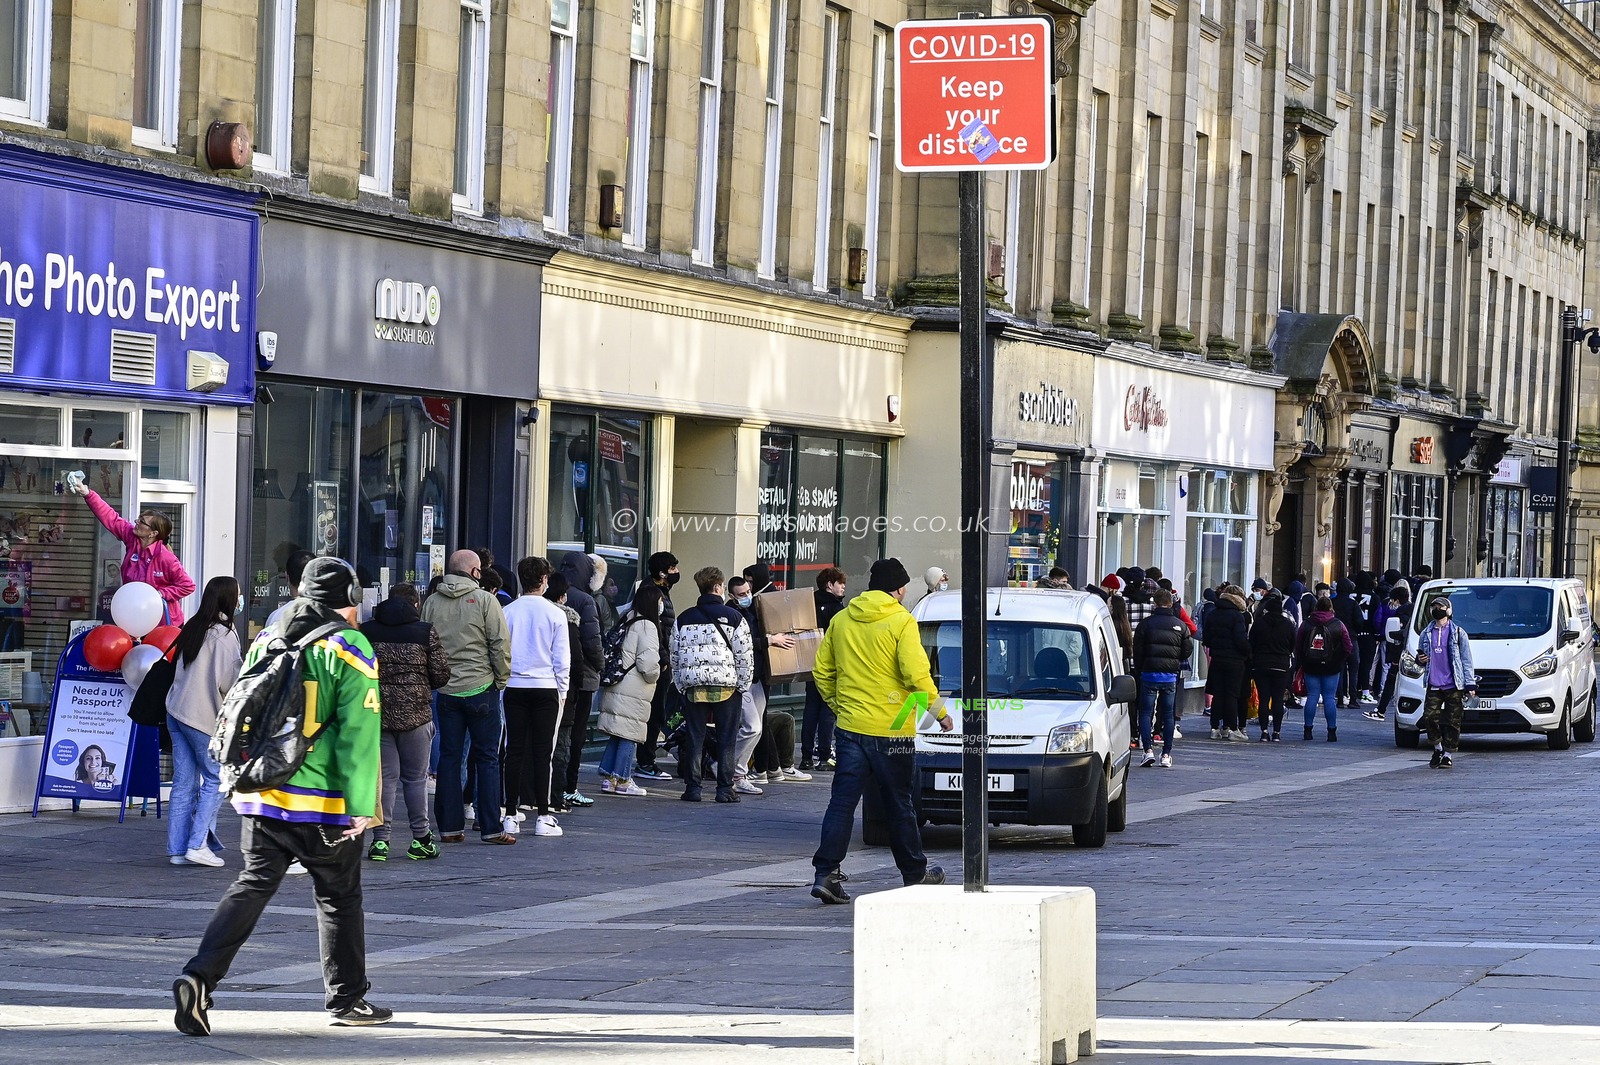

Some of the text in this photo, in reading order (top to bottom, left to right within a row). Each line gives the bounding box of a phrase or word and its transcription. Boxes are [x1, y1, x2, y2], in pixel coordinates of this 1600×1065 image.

[909, 33, 1035, 59] COVID-19
[941, 76, 1004, 101] Keep
[946, 109, 1000, 131] your
[918, 133, 1028, 155] distce
[0, 247, 241, 341] he Photo Expert
[393, 326, 435, 345] SUSHI BOX
[1021, 381, 1078, 427] scribbler
[758, 486, 838, 508] RETAIL &B SPACE
[1010, 462, 1044, 511] bbler
[760, 512, 789, 533] HERE'S
[254, 585, 292, 597] SUSHI SMA
[76, 664, 88, 672] The
[71, 696, 123, 708] Passport?
[73, 685, 100, 696] Need
[110, 688, 125, 698] UK
[94, 781, 113, 789] MAX
